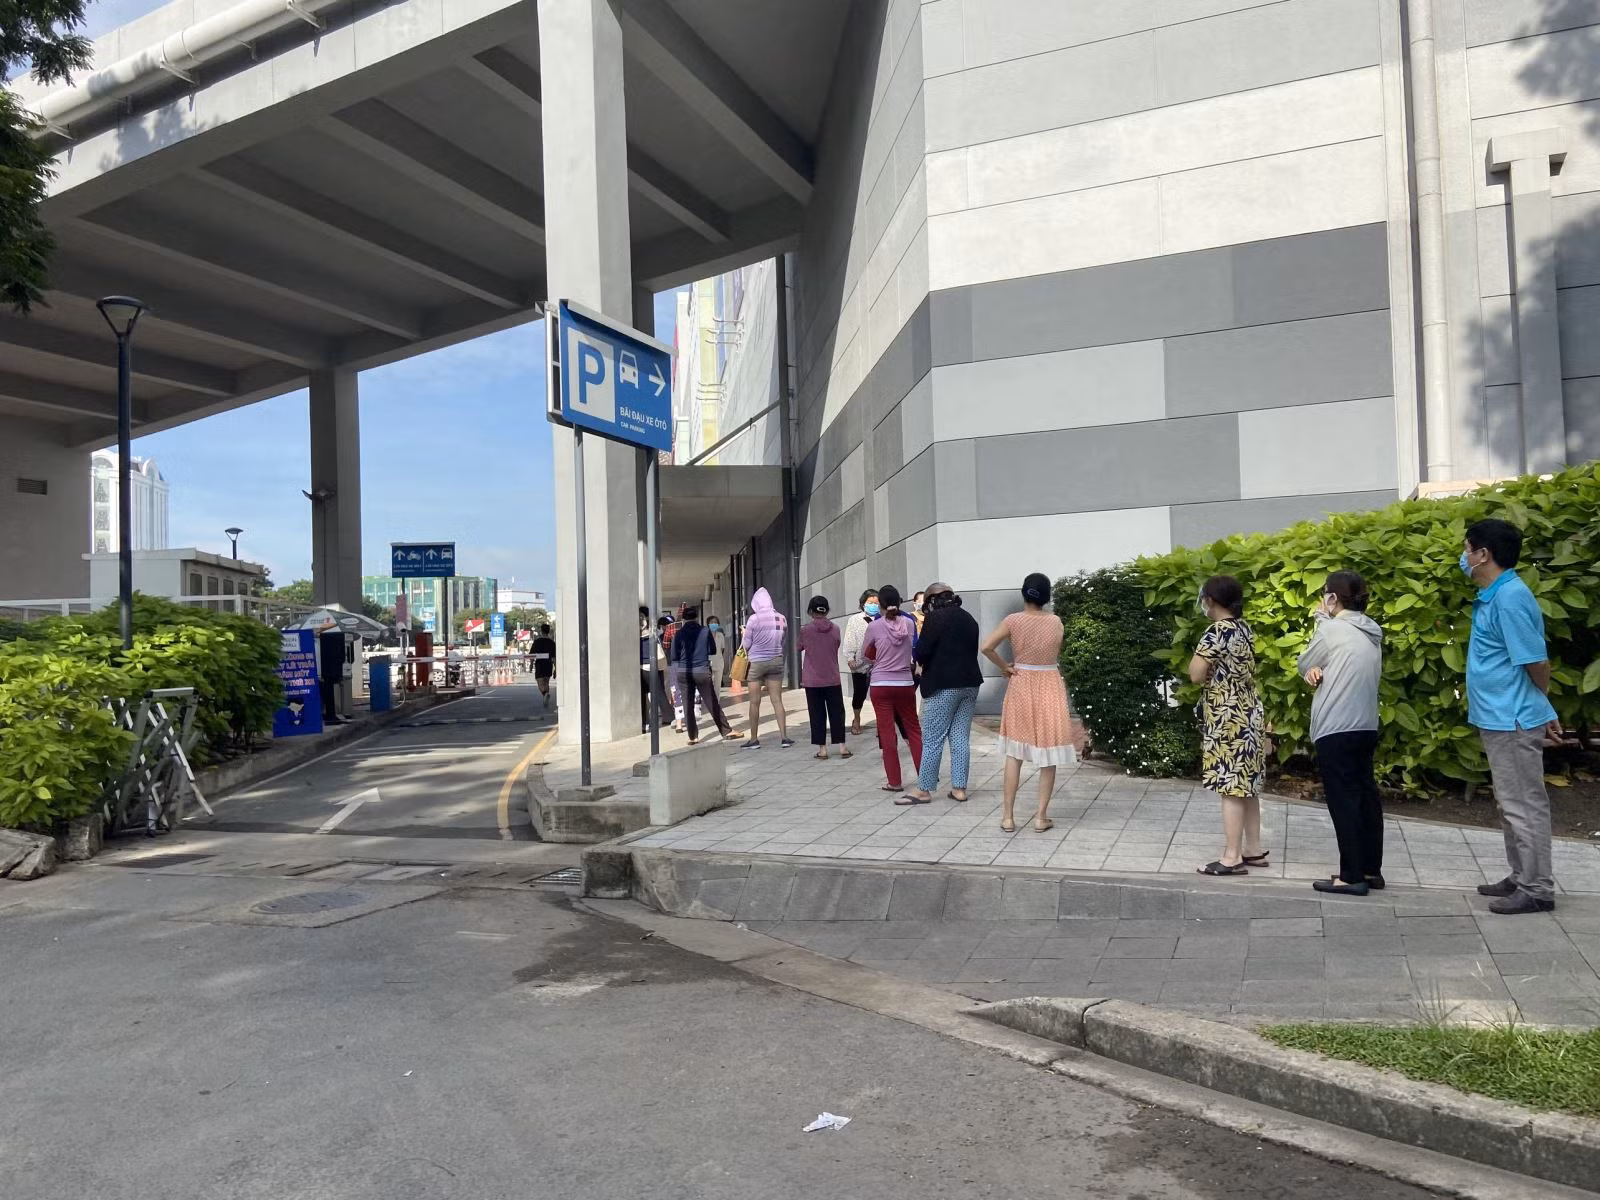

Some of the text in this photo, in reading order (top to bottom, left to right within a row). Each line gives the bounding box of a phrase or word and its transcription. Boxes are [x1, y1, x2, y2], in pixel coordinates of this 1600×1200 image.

[579, 342, 605, 404] P
[646, 415, 654, 426] XE
[629, 424, 645, 434] PARKING
